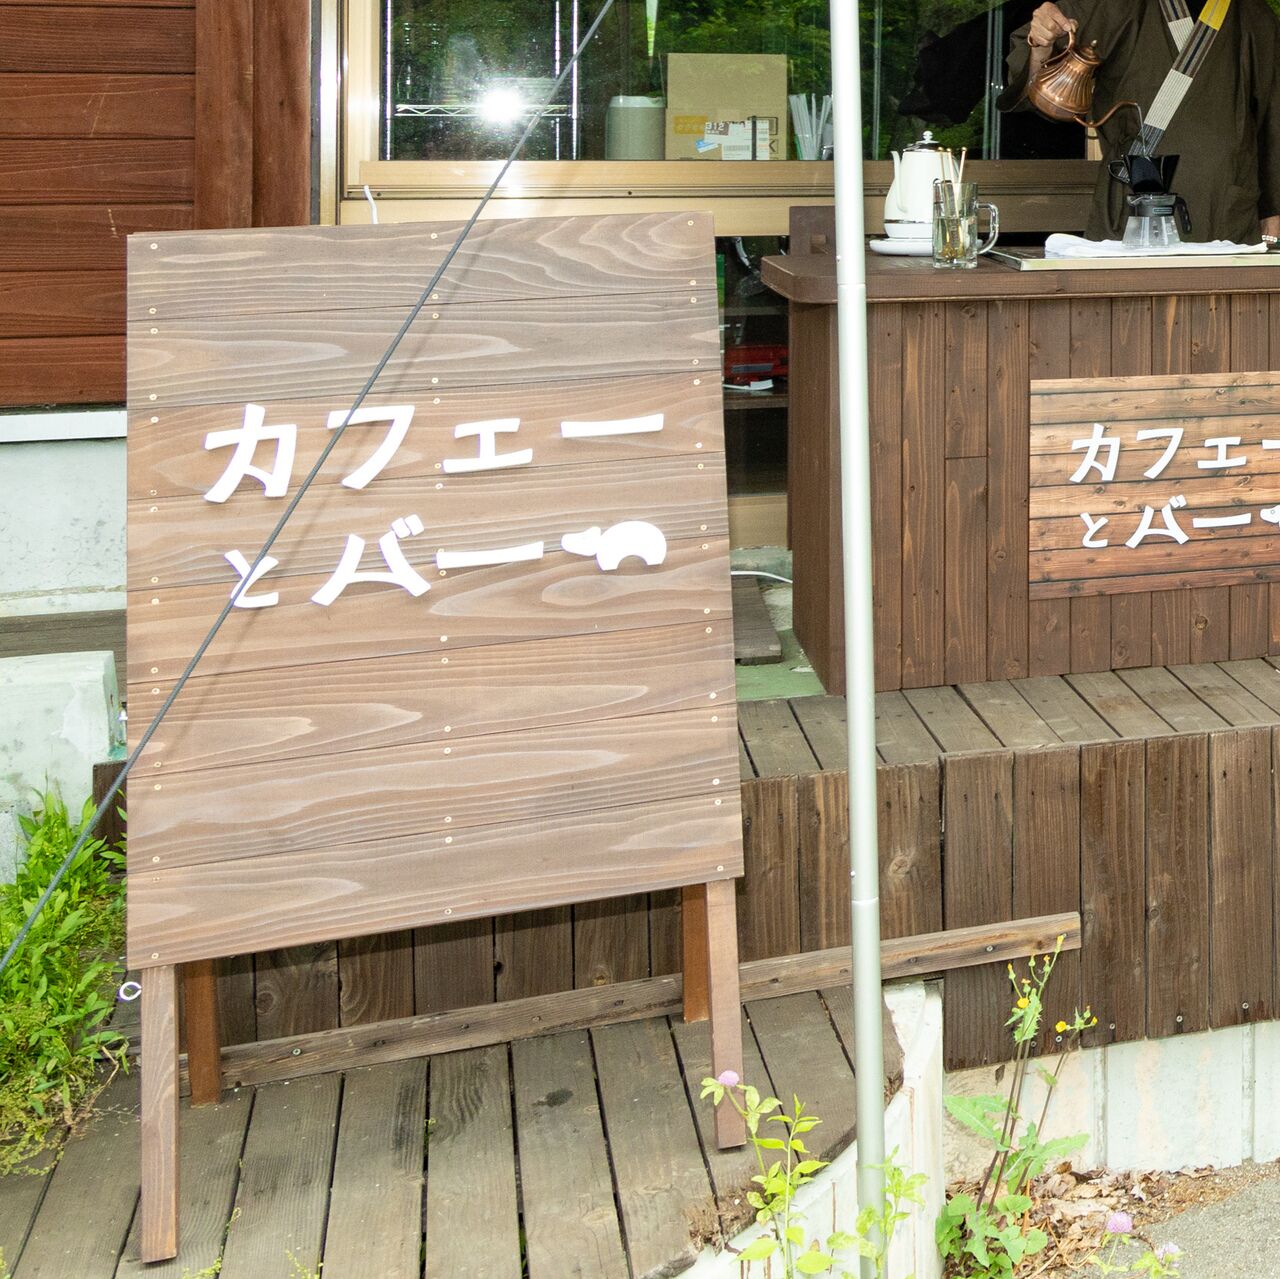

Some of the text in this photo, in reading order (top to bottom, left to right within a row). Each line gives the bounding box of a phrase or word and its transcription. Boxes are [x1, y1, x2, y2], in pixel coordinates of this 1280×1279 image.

[202, 404, 665, 503] カフェー
[223, 514, 544, 609] とバー
[1080, 494, 1252, 549] とバー
